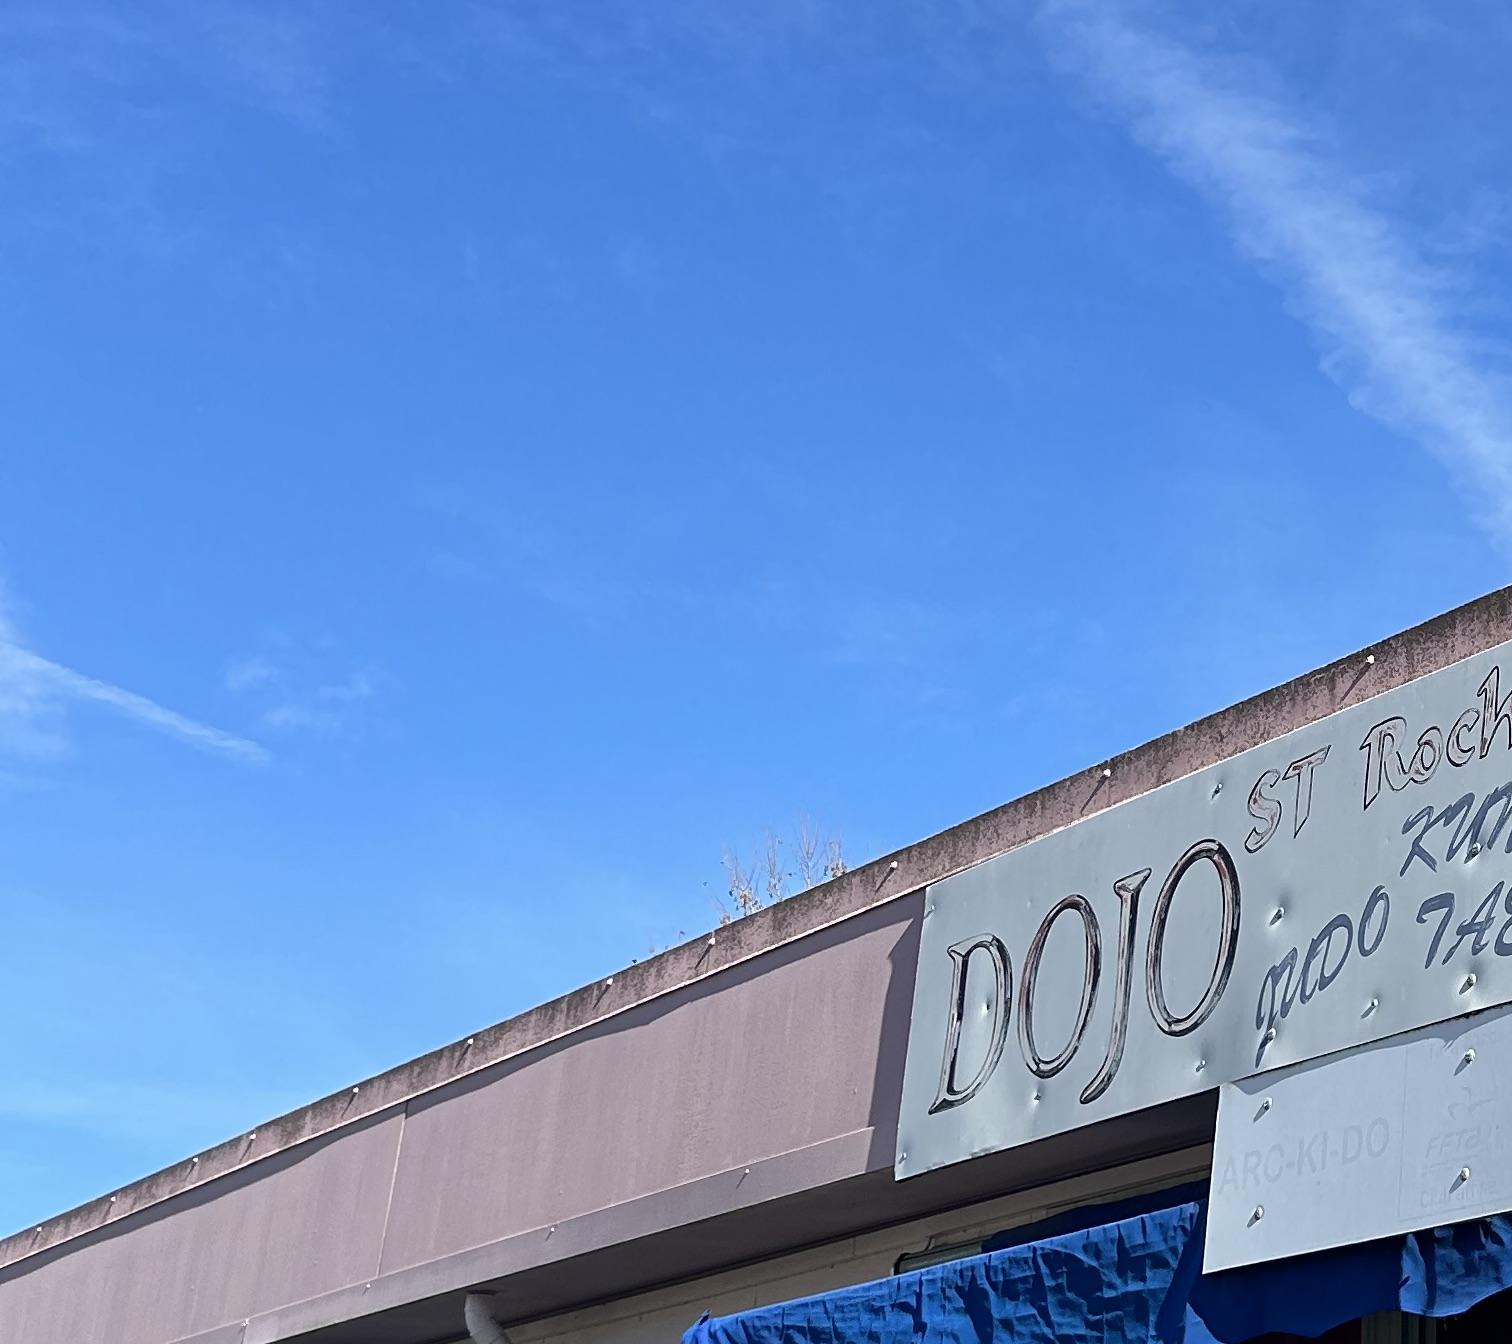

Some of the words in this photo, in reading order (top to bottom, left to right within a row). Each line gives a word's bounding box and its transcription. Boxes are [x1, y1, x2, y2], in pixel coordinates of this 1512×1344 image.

[928, 838, 1241, 1115] DOJO
[1245, 744, 1332, 854] ST
[1254, 885, 1391, 1069] JUDO
